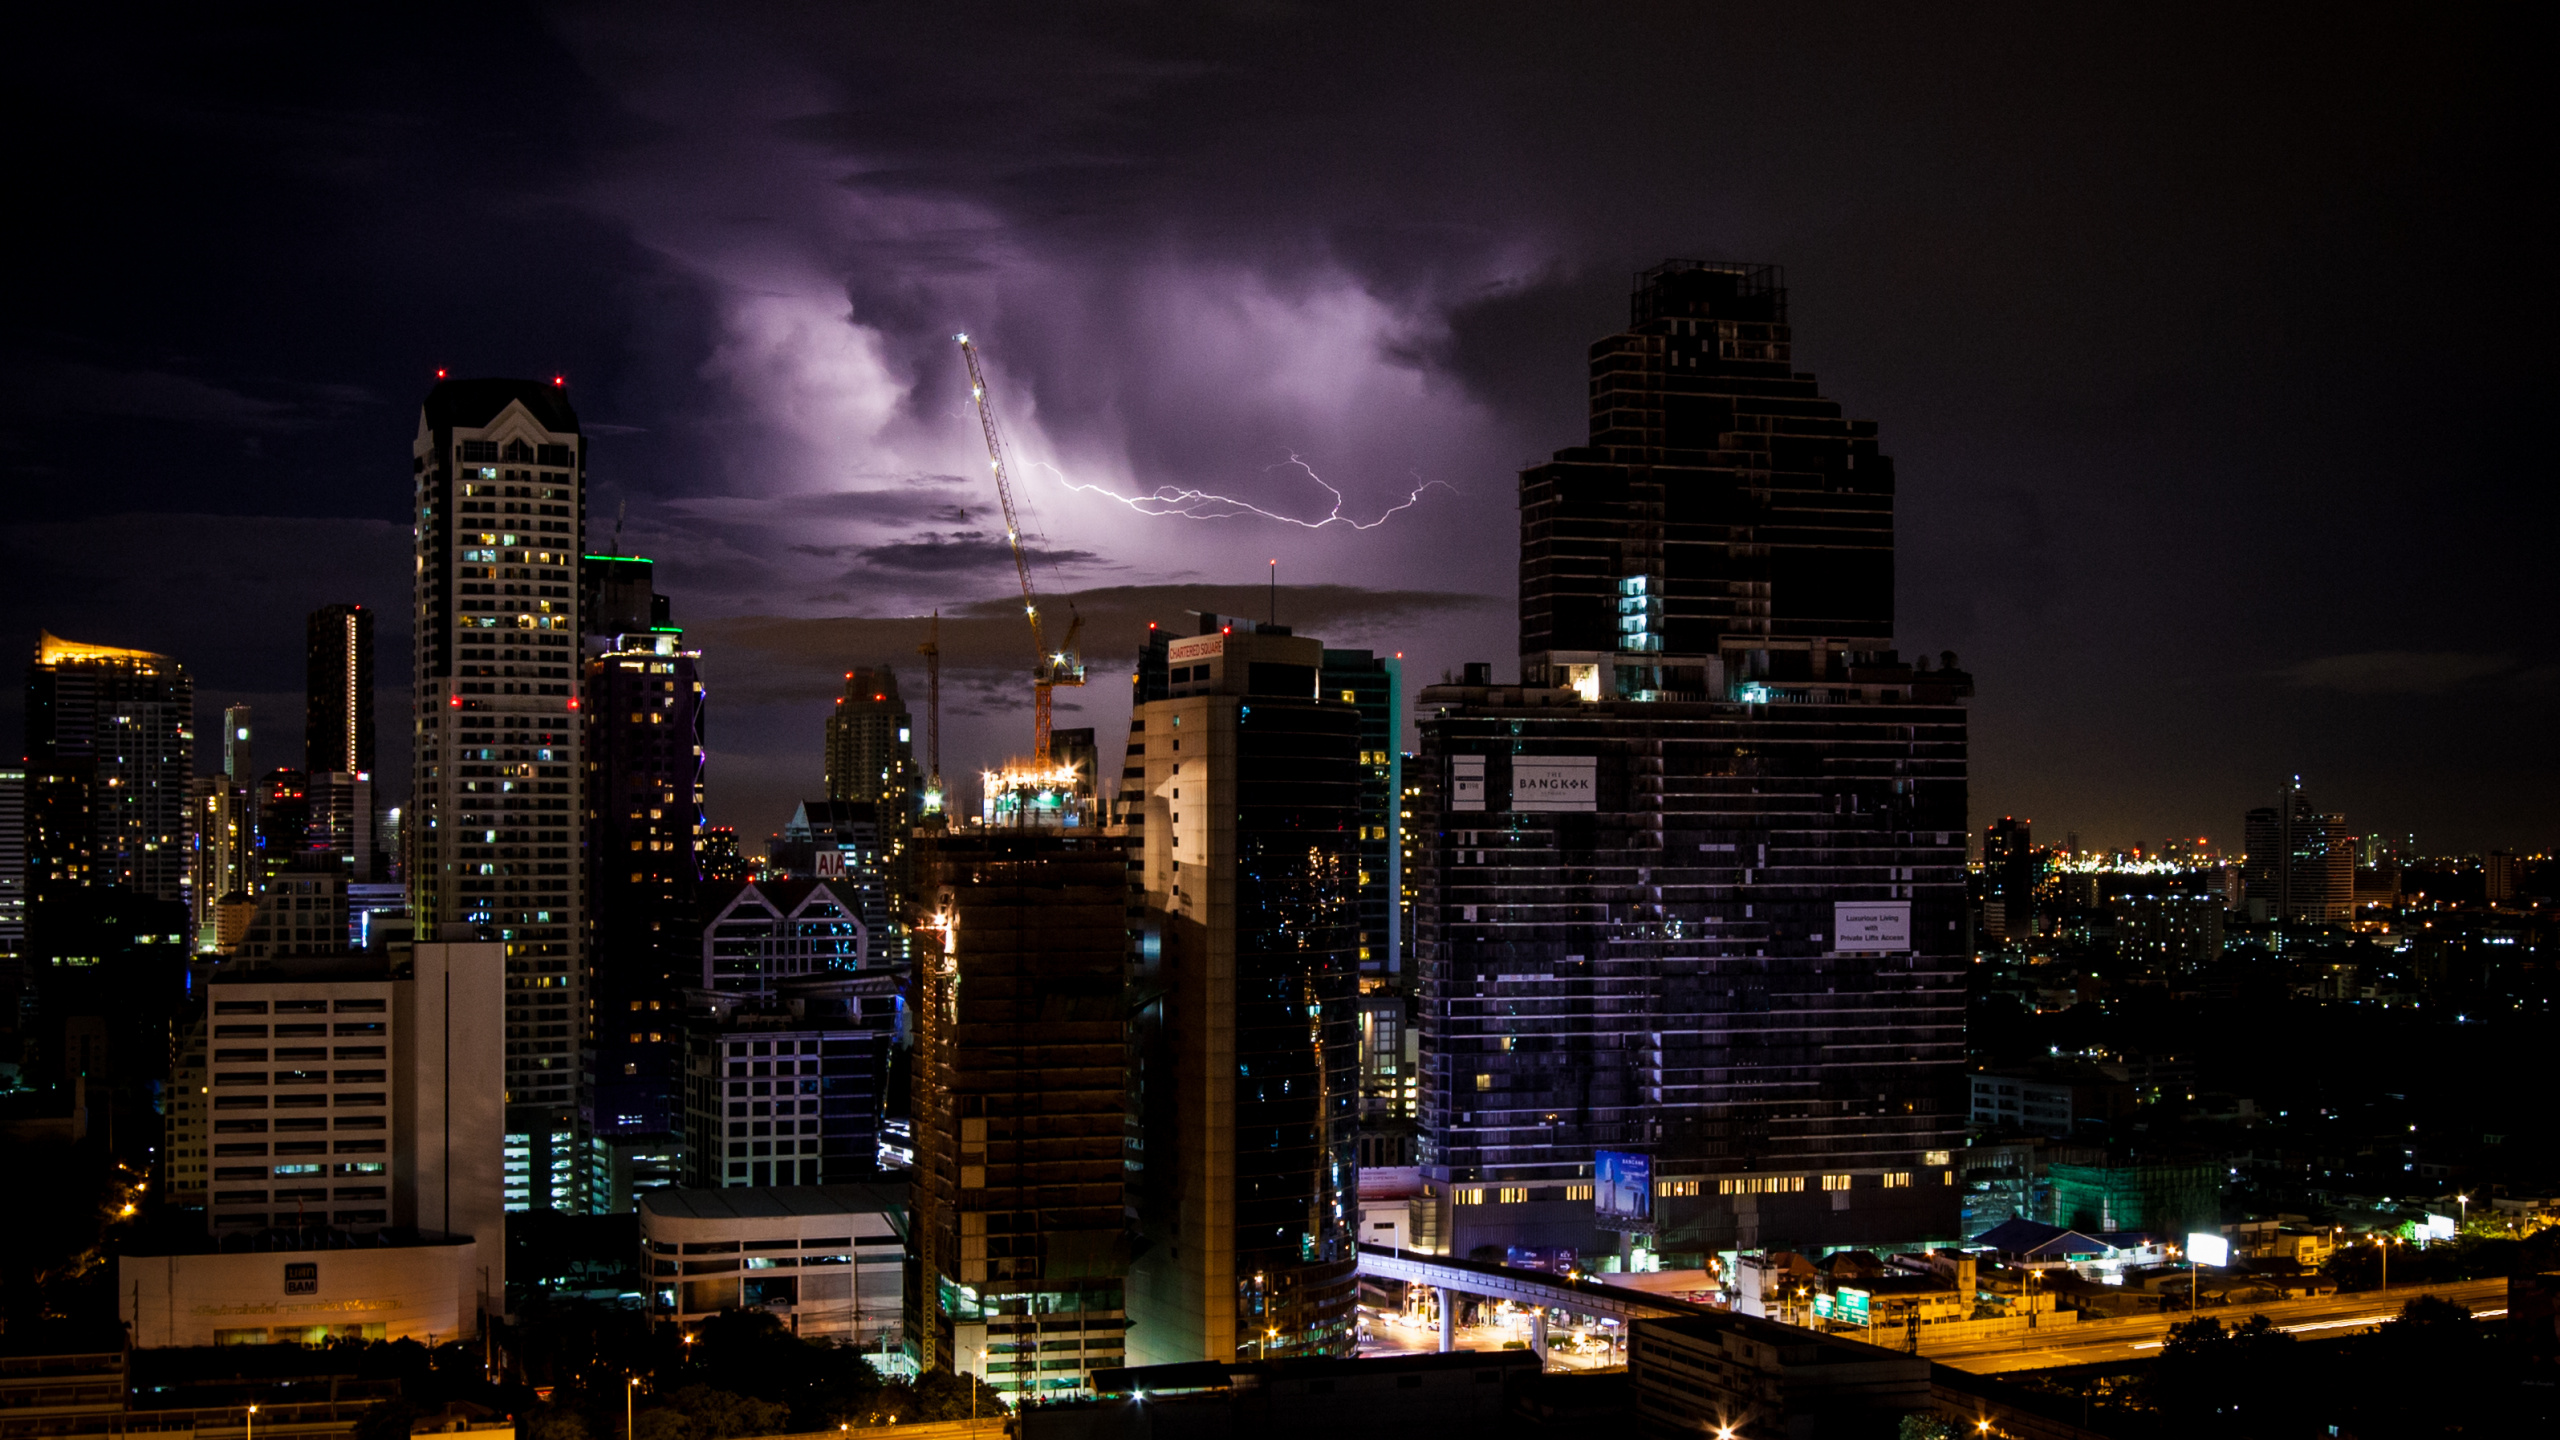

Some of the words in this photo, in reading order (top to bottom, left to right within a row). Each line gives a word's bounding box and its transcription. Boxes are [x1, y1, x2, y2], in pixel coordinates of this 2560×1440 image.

[1169, 644, 1200, 660] CHARTERED
[1200, 640, 1222, 655] SQUARE
[818, 854, 846, 875] AIA
[288, 1281, 315, 1292] BAM
